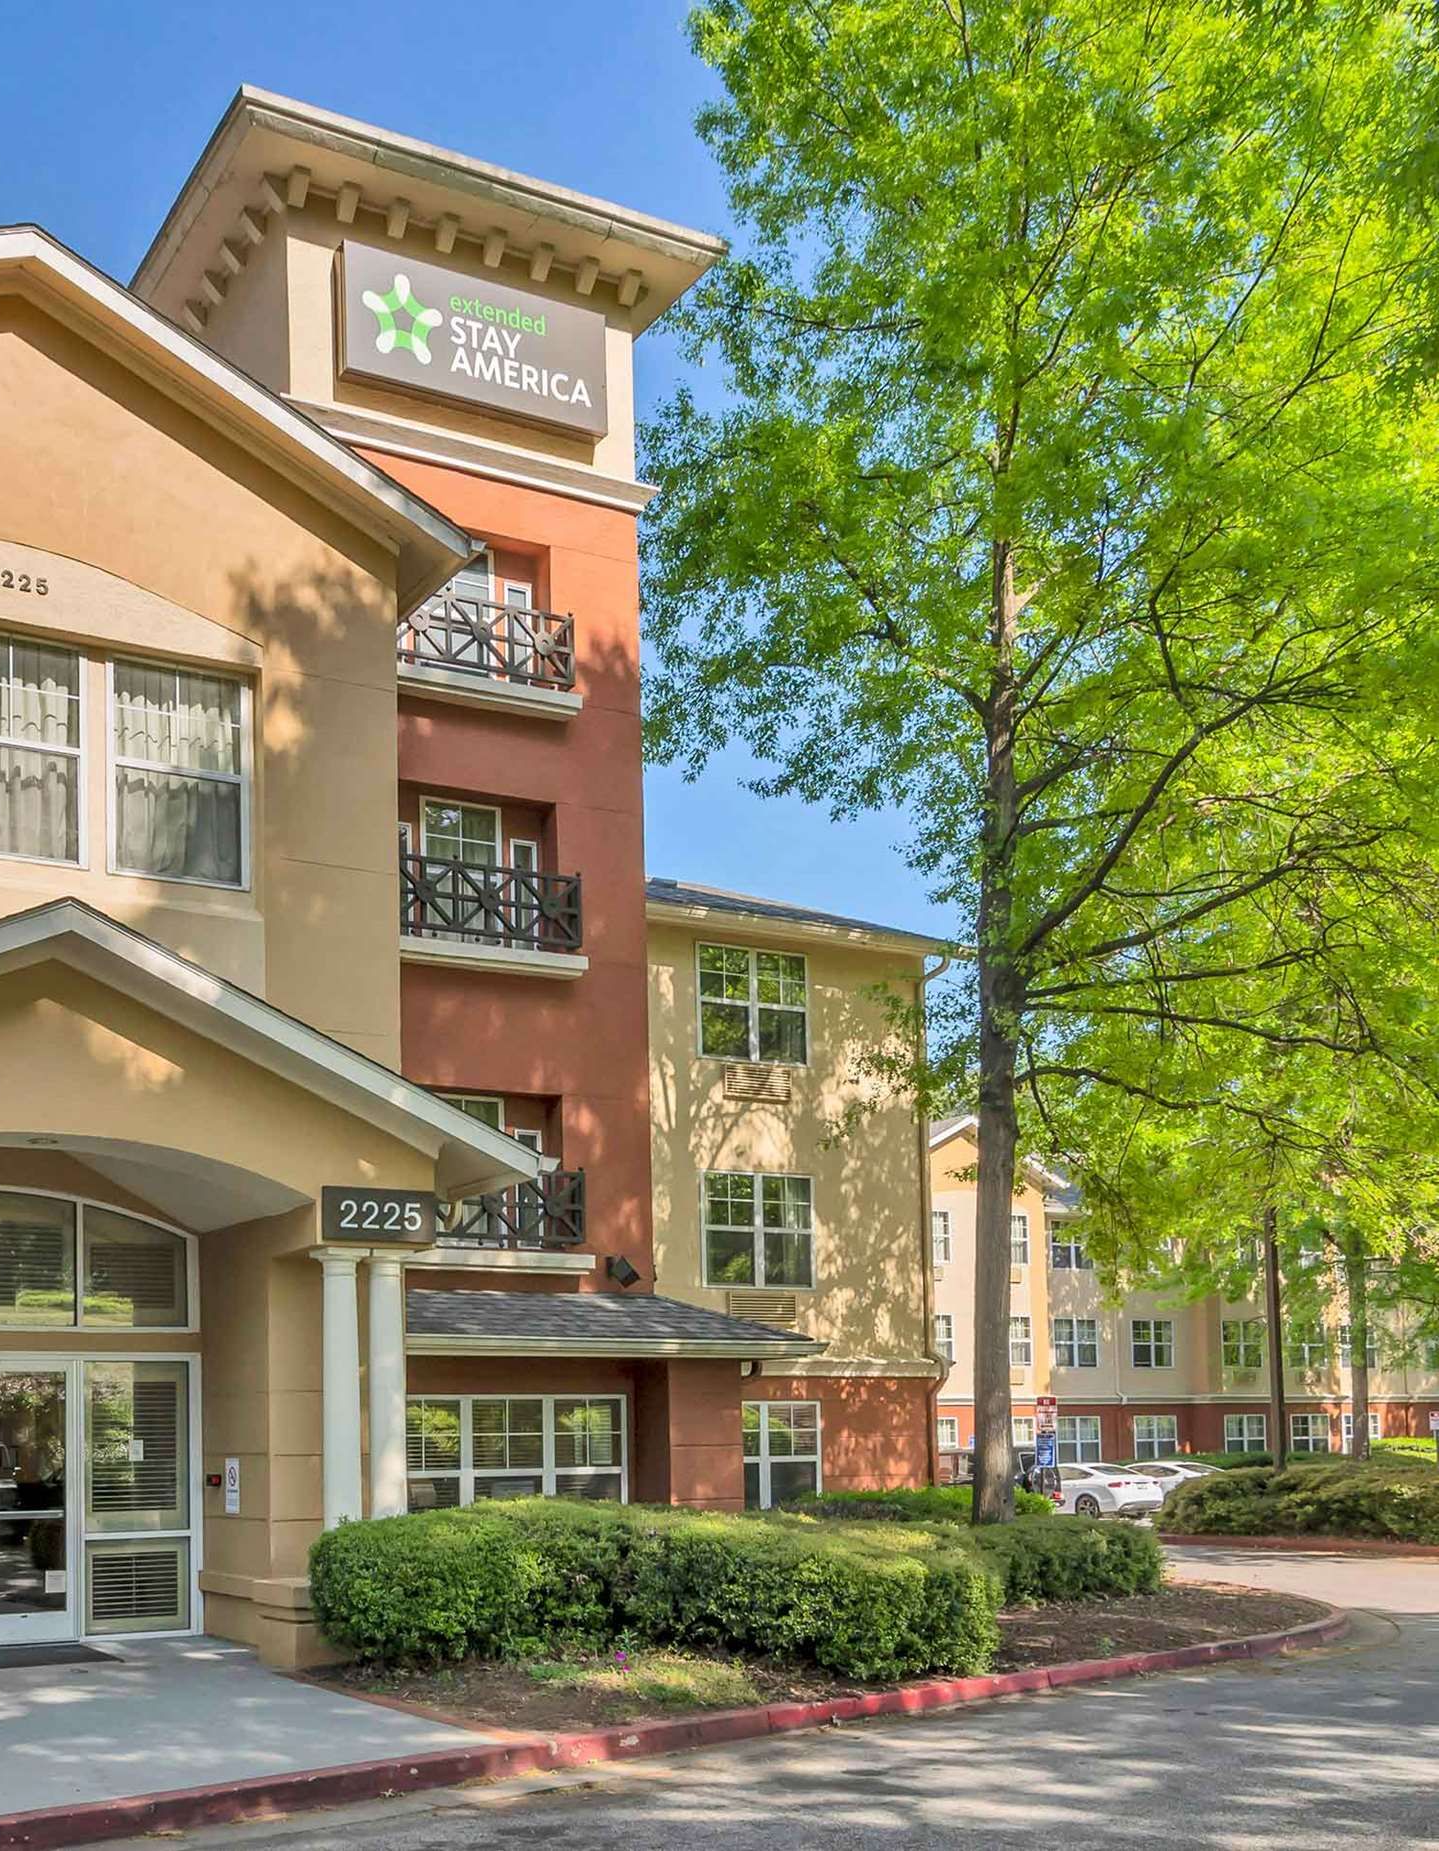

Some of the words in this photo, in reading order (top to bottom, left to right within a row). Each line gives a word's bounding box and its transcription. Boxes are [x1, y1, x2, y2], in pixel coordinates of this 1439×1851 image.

[449, 295, 546, 336] extended
[450, 317, 521, 358] STAY
[450, 347, 592, 408] AMERICA
[340, 1200, 422, 1231] 2225
